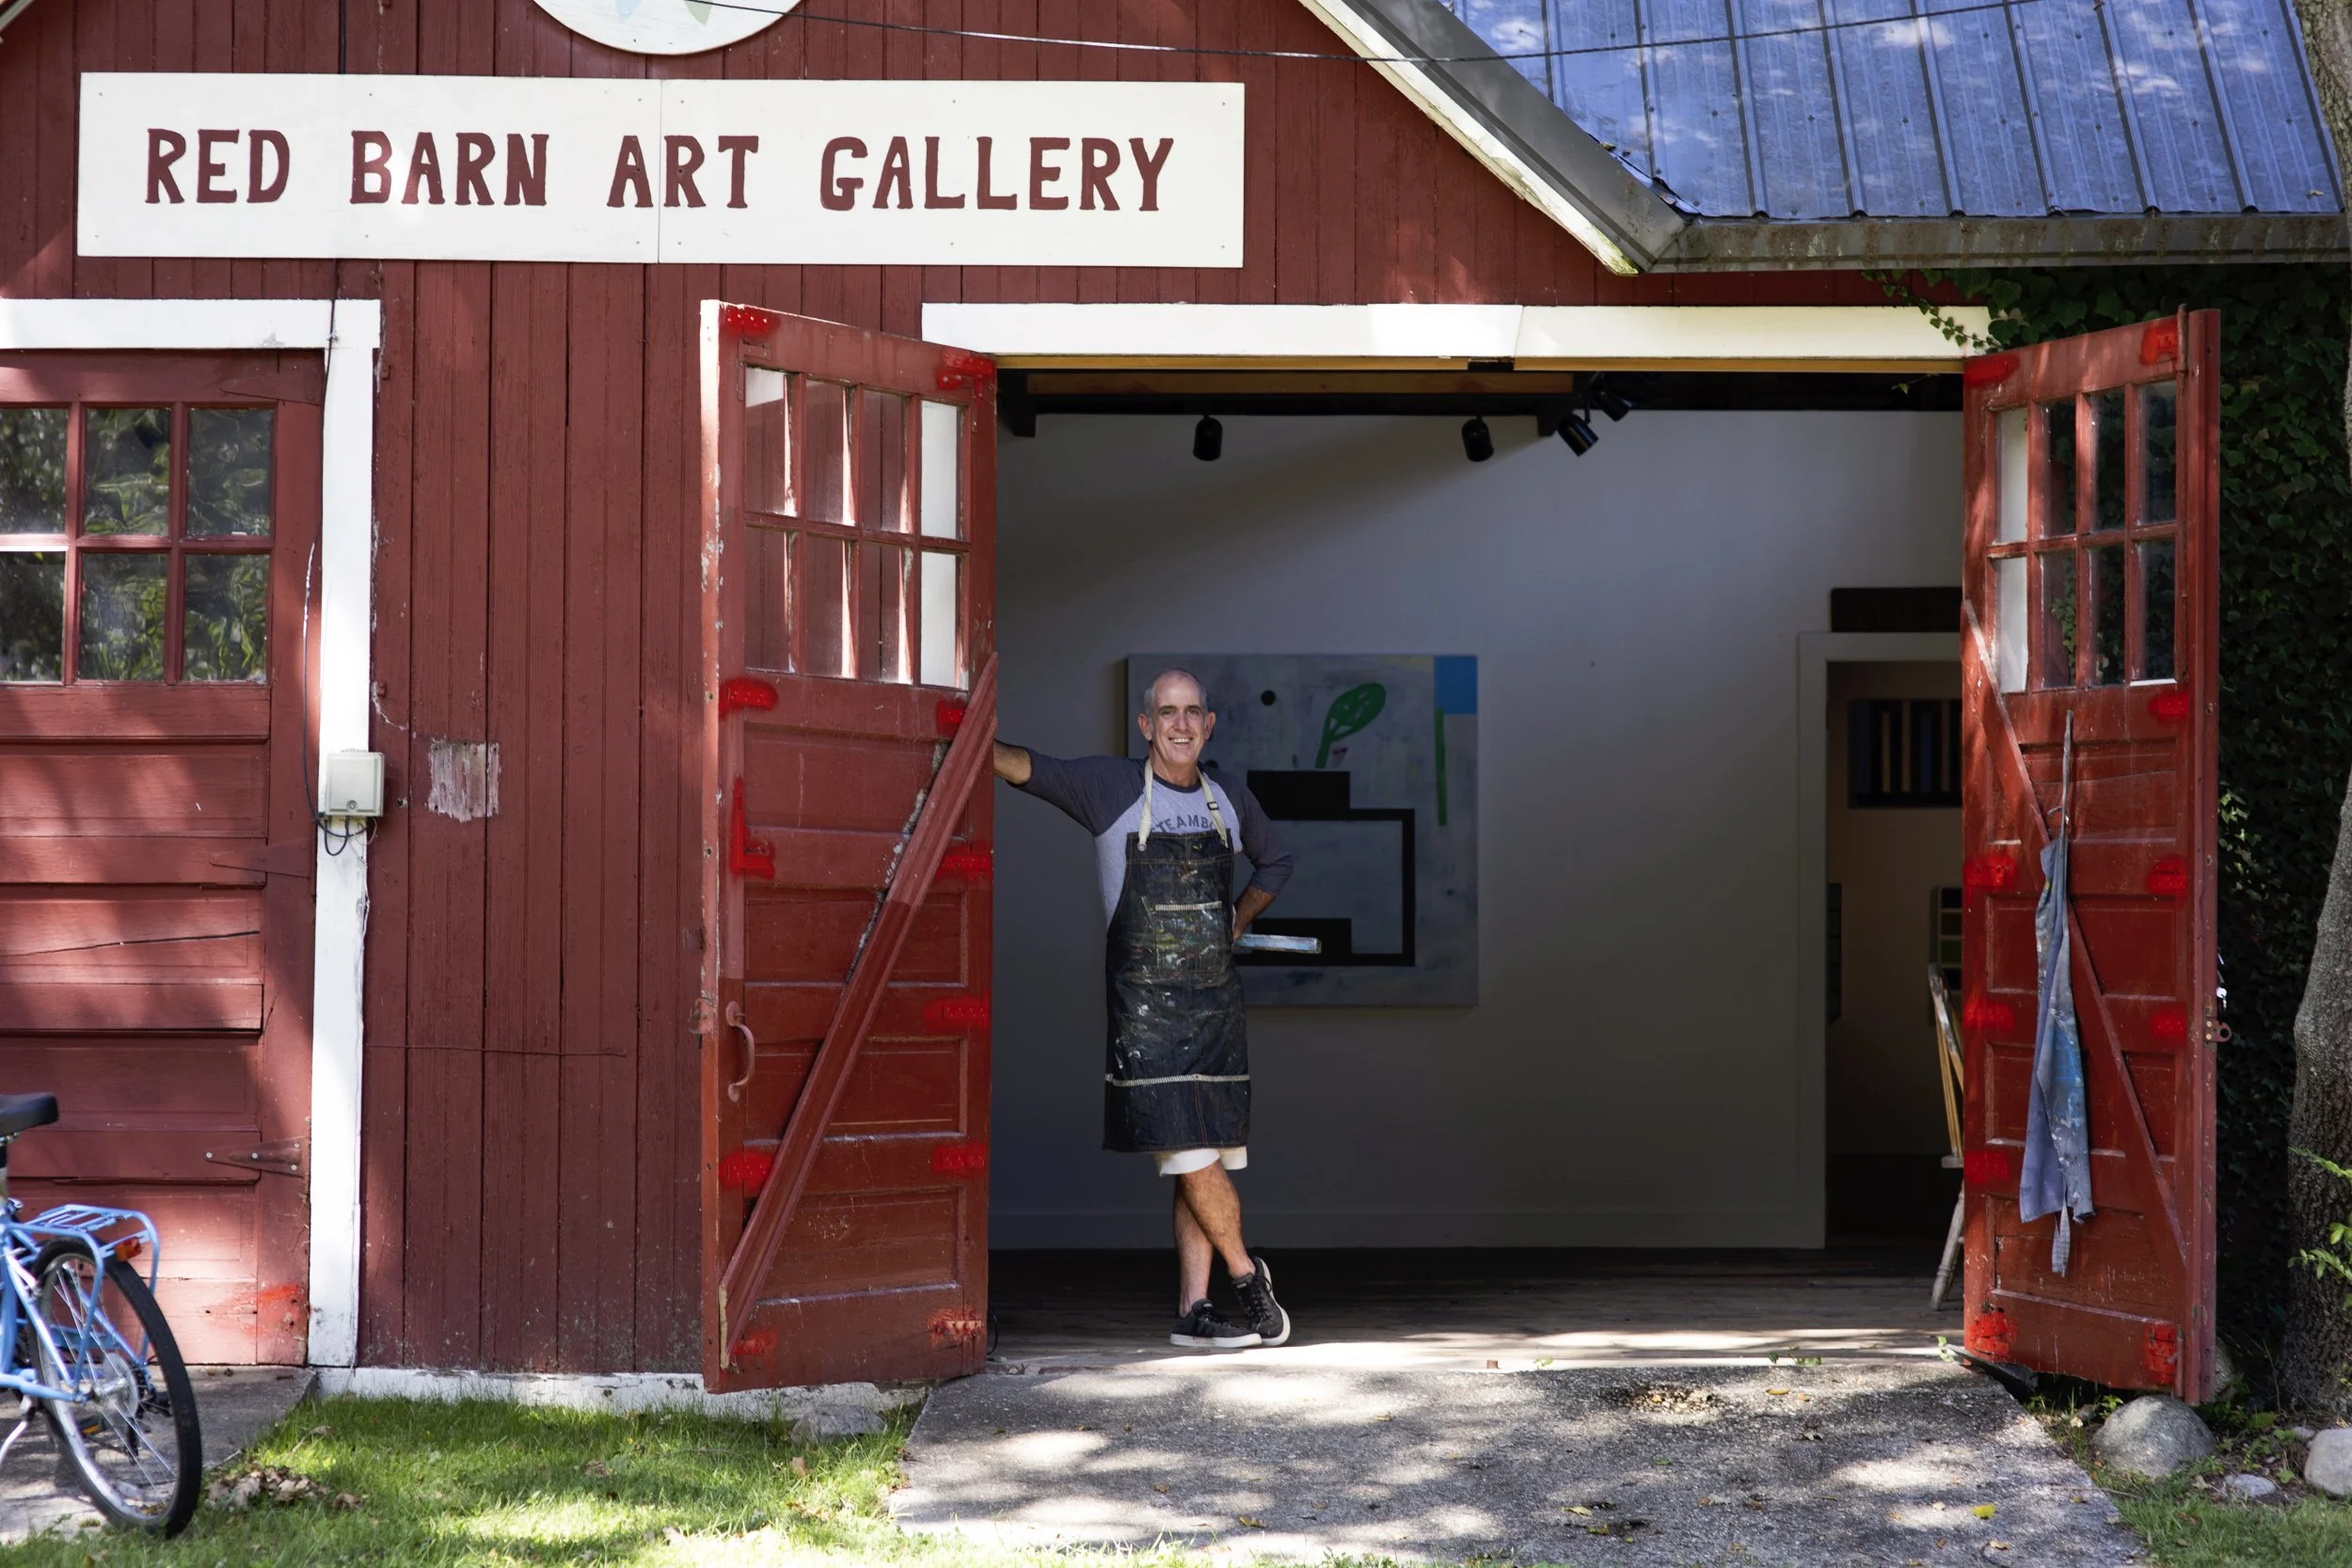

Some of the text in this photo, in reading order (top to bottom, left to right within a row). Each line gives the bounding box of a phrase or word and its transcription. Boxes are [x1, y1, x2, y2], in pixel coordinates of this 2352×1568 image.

[146, 128, 1174, 212] RED BARN ART GALLERY
[1152, 815, 1213, 832] TEAMB
